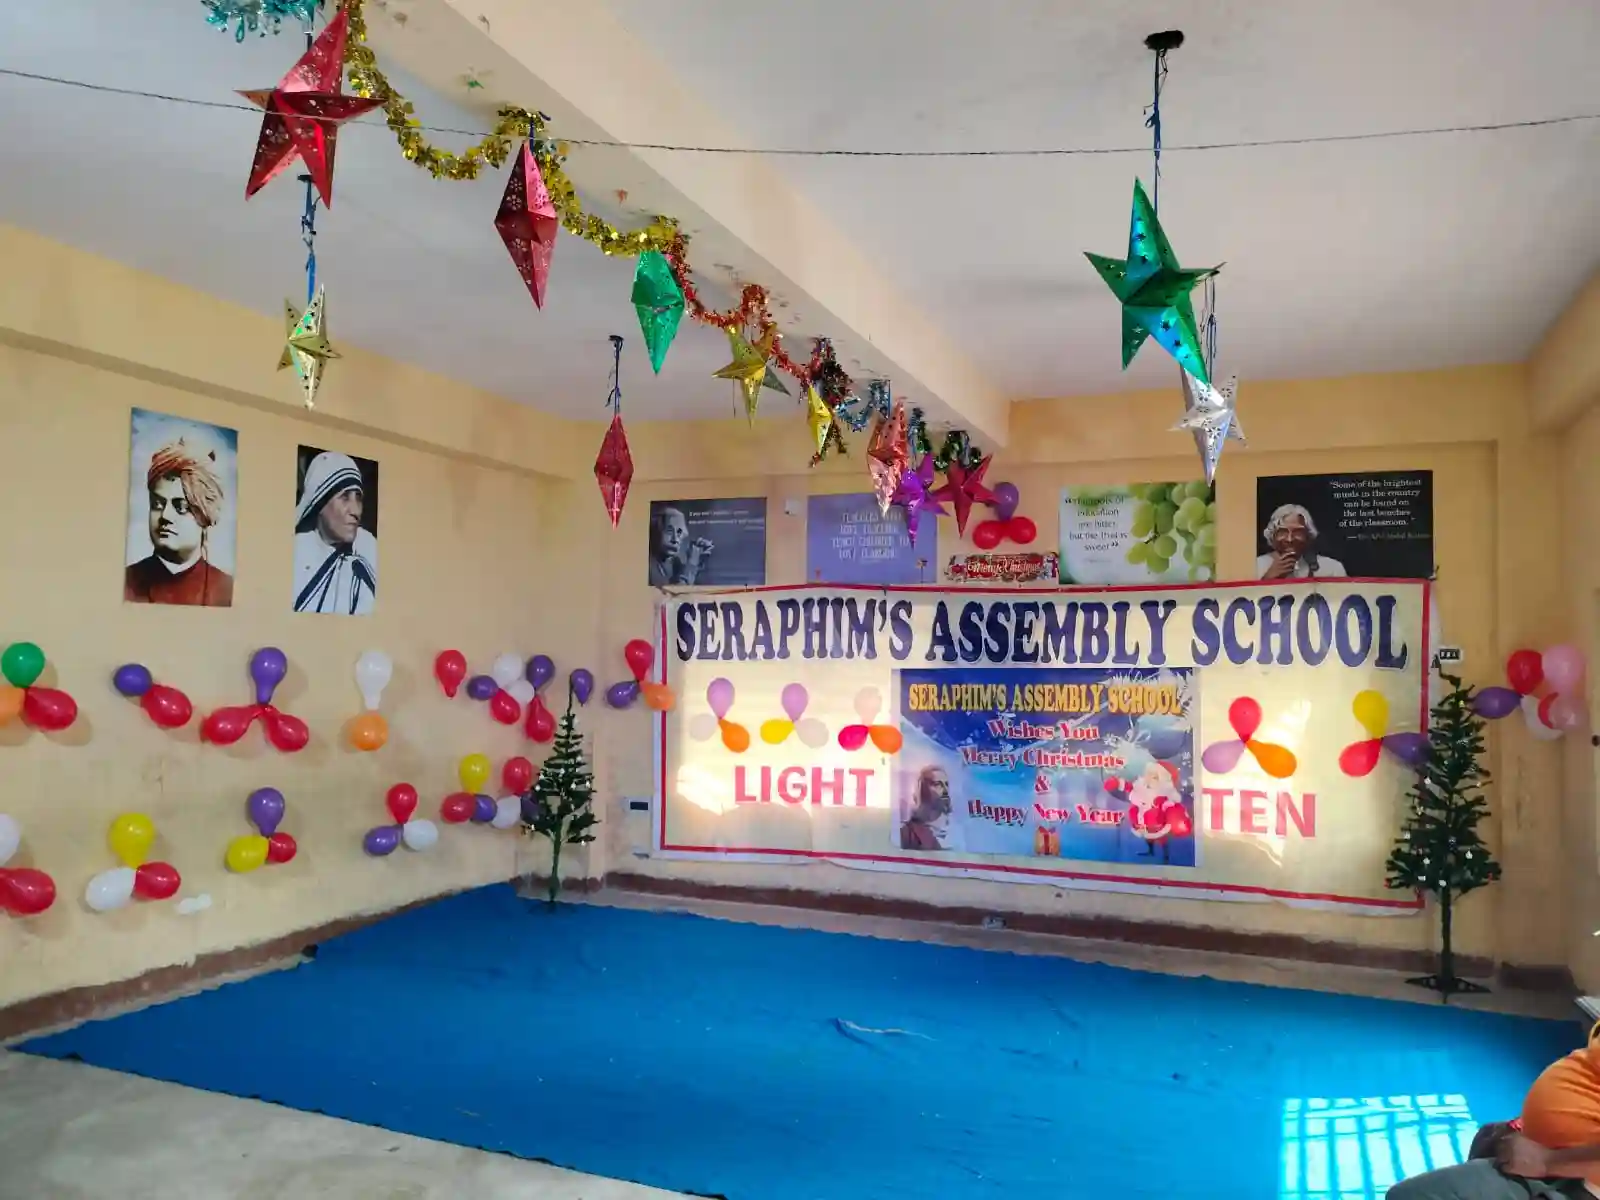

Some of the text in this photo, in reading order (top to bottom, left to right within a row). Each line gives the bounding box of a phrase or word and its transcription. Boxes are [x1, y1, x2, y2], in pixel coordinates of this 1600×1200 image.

[1361, 499, 1370, 508] be
[1372, 498, 1397, 507] found
[1372, 489, 1386, 498] the
[1387, 489, 1421, 498] country
[1338, 519, 1349, 528] of
[1343, 509, 1357, 518] the
[675, 593, 1408, 670] SERAPHIM'S ASSEMBLY SCHOOL
[908, 683, 1183, 716] SERAPHIM'S ASSEMBLY SCHOOL
[987, 718, 1100, 742] Wishes You
[959, 746, 1125, 769] Merry Christmas
[734, 765, 875, 807] LIGHT
[1034, 774, 1050, 794] &
[967, 799, 1125, 827] Happy New Year
[1201, 787, 1317, 838] TEN
